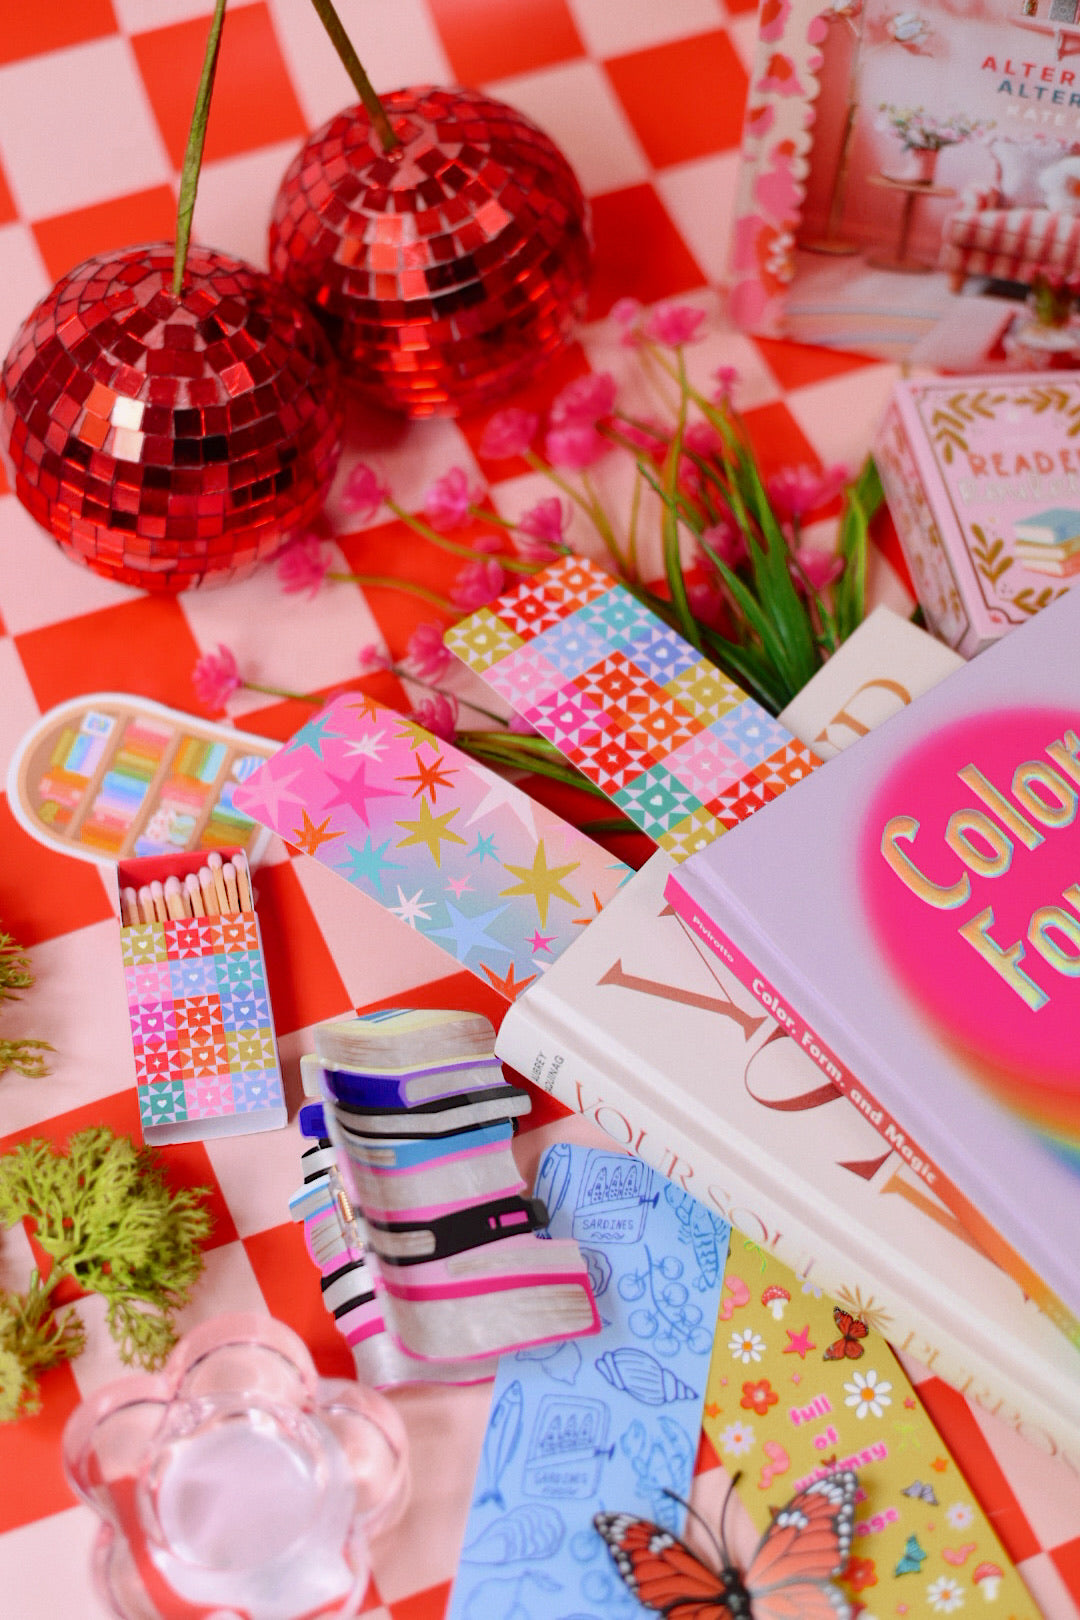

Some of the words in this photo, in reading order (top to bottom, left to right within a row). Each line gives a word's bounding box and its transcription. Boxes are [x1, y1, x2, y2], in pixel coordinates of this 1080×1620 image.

[981, 55, 1076, 87] ALTER
[997, 79, 1080, 108] ALTER
[967, 447, 1080, 478] READE
[692, 915, 735, 963] Pivirotto
[958, 883, 1080, 1013] Fo
[533, 1051, 547, 1082] UBREY
[850, 1088, 884, 1126] and
[885, 1123, 937, 1184] Magic
[582, 1217, 634, 1231] SARDINES
[790, 1393, 832, 1427] full
[813, 1424, 839, 1451] of
[855, 1506, 900, 1538] age
